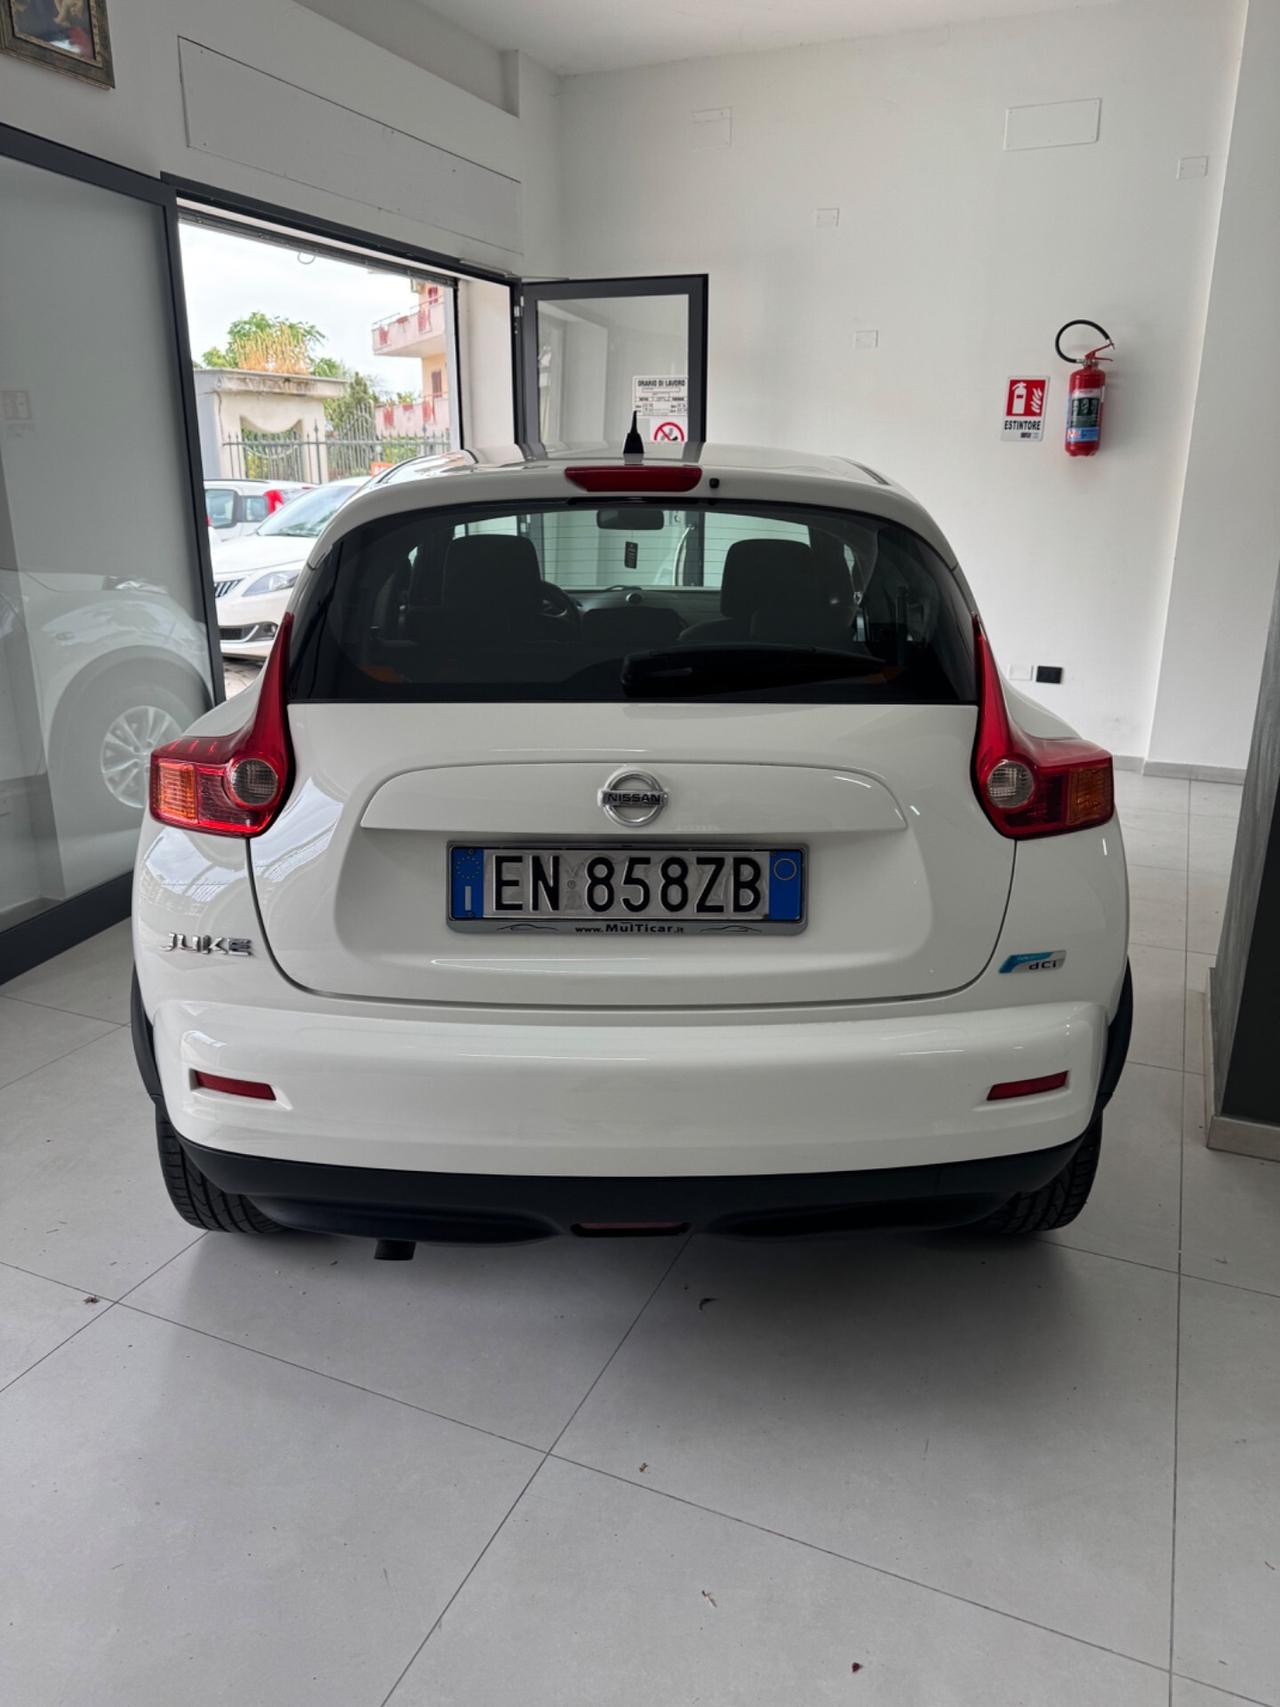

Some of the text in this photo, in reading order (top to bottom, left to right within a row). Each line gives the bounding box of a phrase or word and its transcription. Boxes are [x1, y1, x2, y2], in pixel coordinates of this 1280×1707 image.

[1004, 420, 1041, 430] ESTINTORE
[607, 793, 660, 804] NISSAN
[495, 855, 761, 913] EN 858ZB
[160, 931, 253, 956] JUKE
[1028, 960, 1056, 970] dCi
